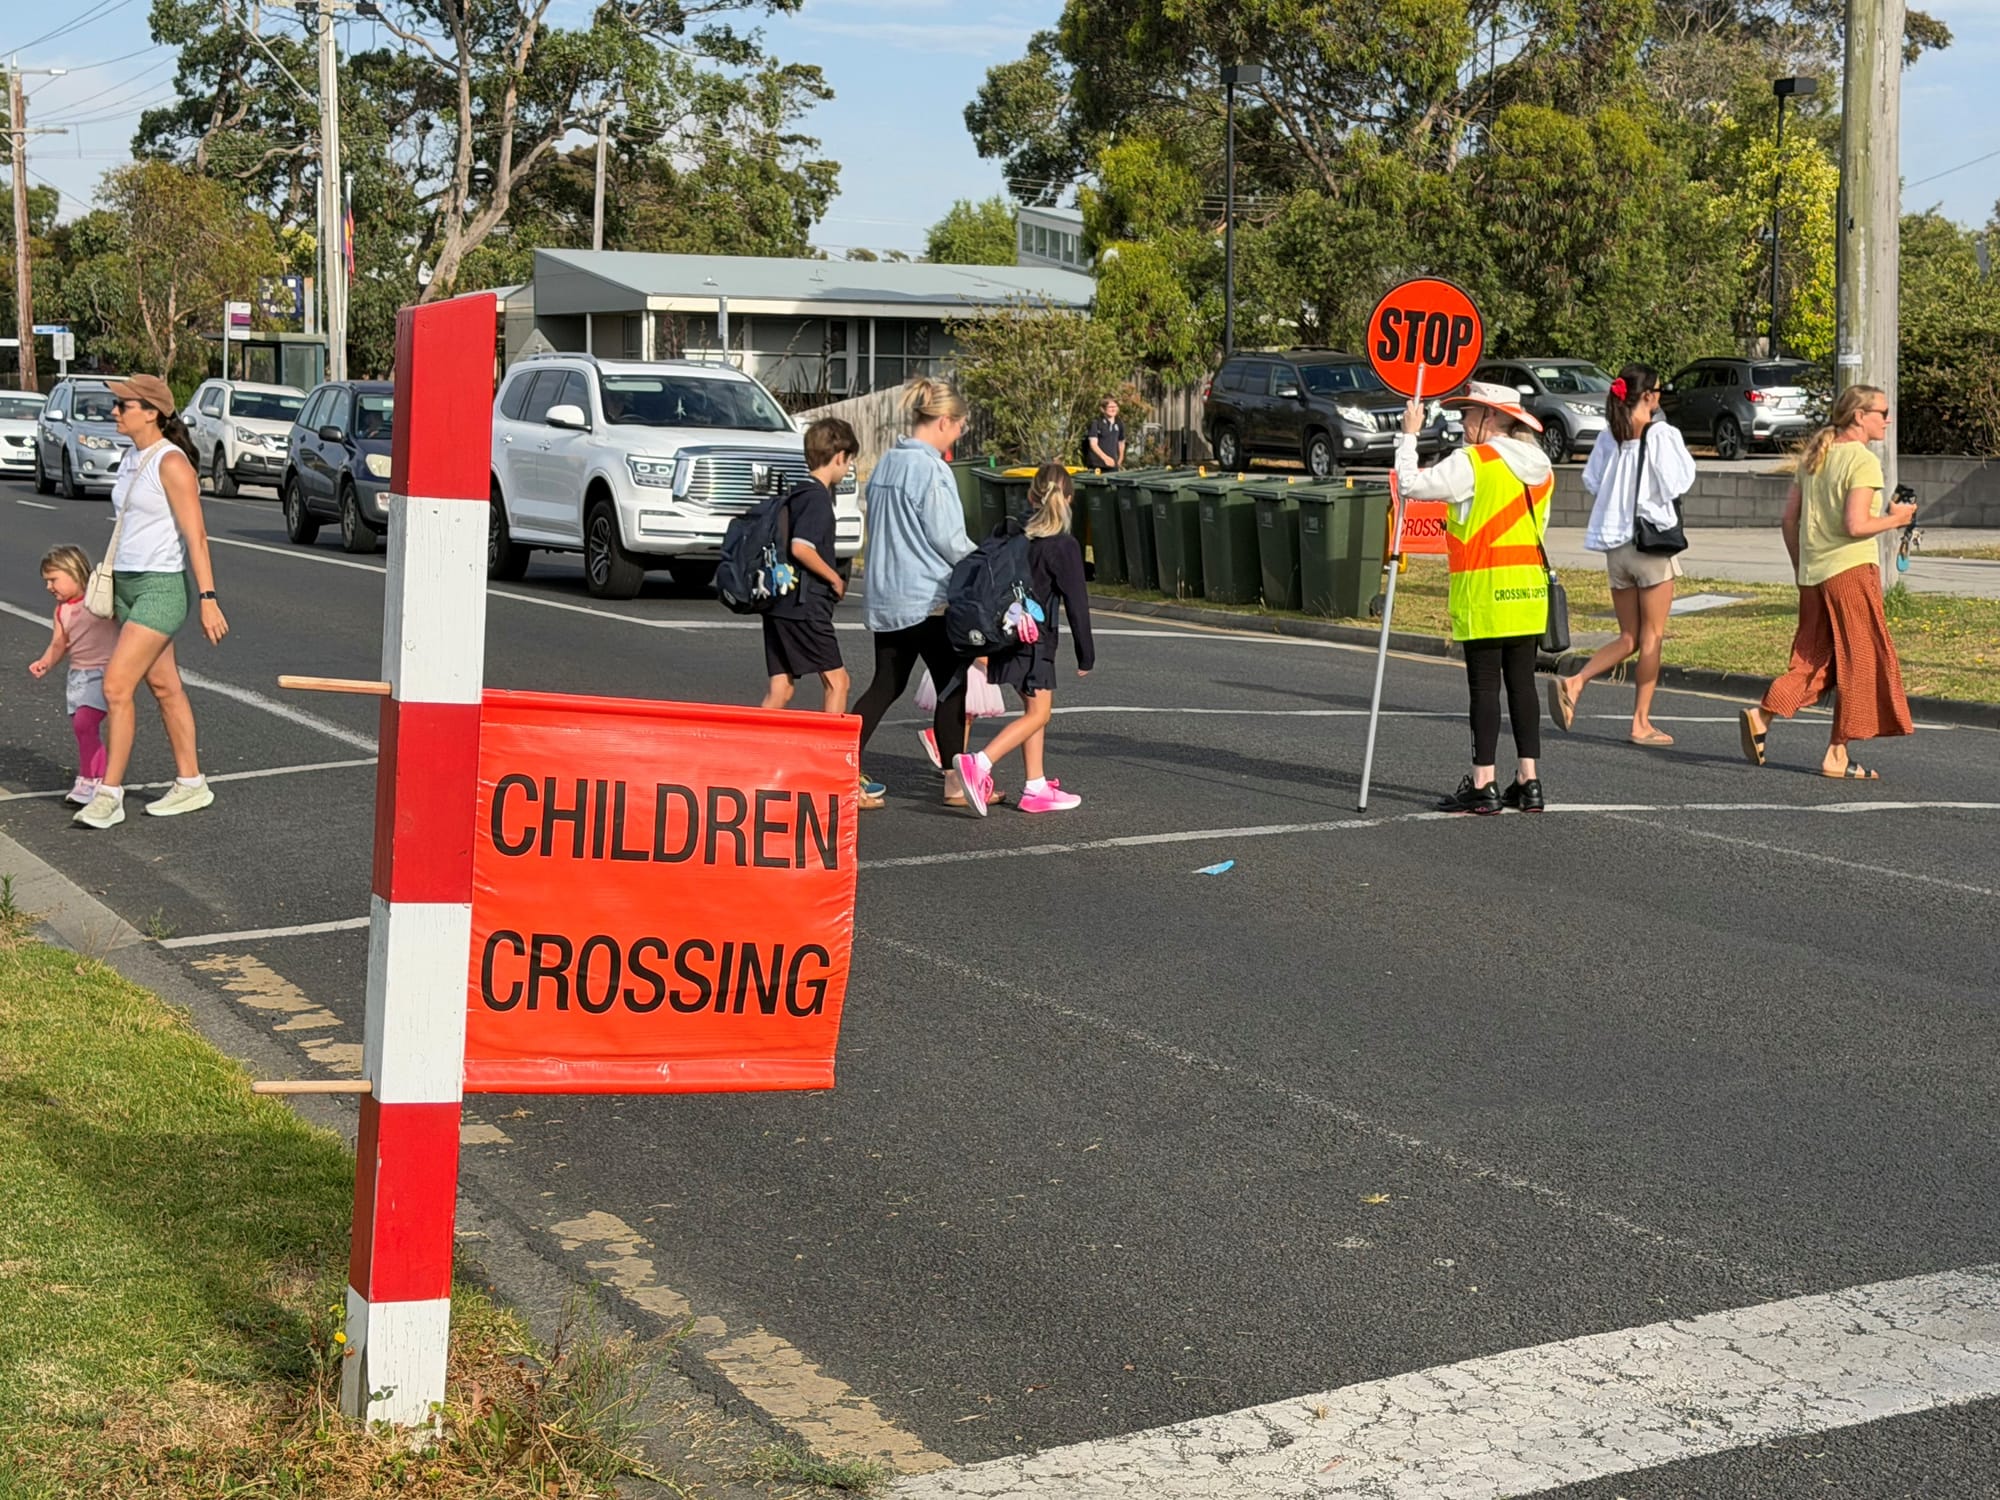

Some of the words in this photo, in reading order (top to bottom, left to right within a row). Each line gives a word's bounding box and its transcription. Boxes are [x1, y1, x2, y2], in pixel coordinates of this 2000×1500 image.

[1377, 307, 1474, 367] STOP
[1494, 587, 1531, 601] CROSSING
[490, 773, 840, 871] CHILDREN
[480, 929, 831, 1018] CROSSING
